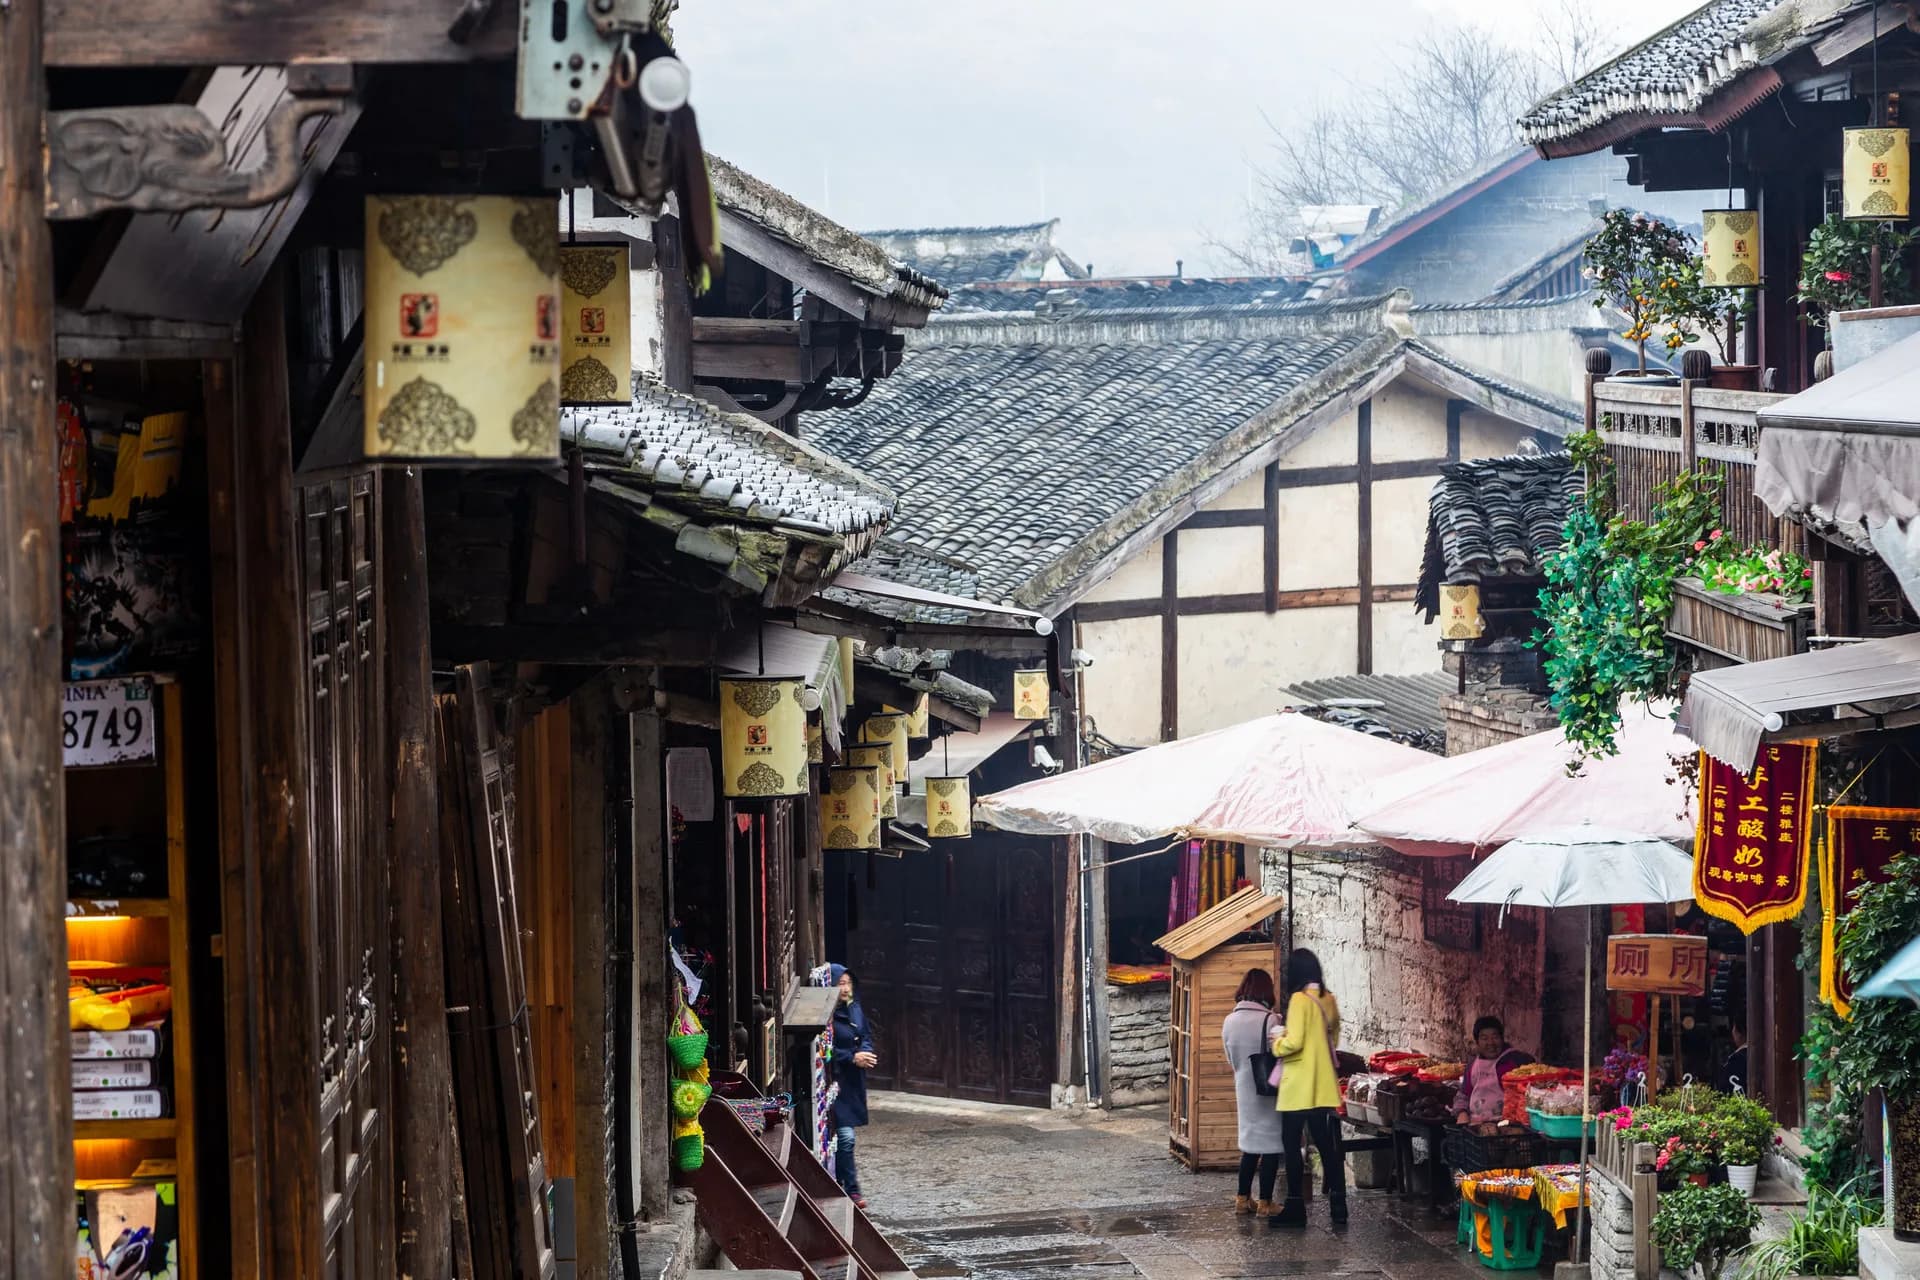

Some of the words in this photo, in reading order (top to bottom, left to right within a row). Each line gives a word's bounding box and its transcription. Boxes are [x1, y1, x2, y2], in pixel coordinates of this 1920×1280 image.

[63, 706, 143, 749] 8749
[1733, 766, 1769, 868] 手工酸奶
[1778, 792, 1796, 843] 二楼雅座
[1612, 943, 1707, 981] 厕所
